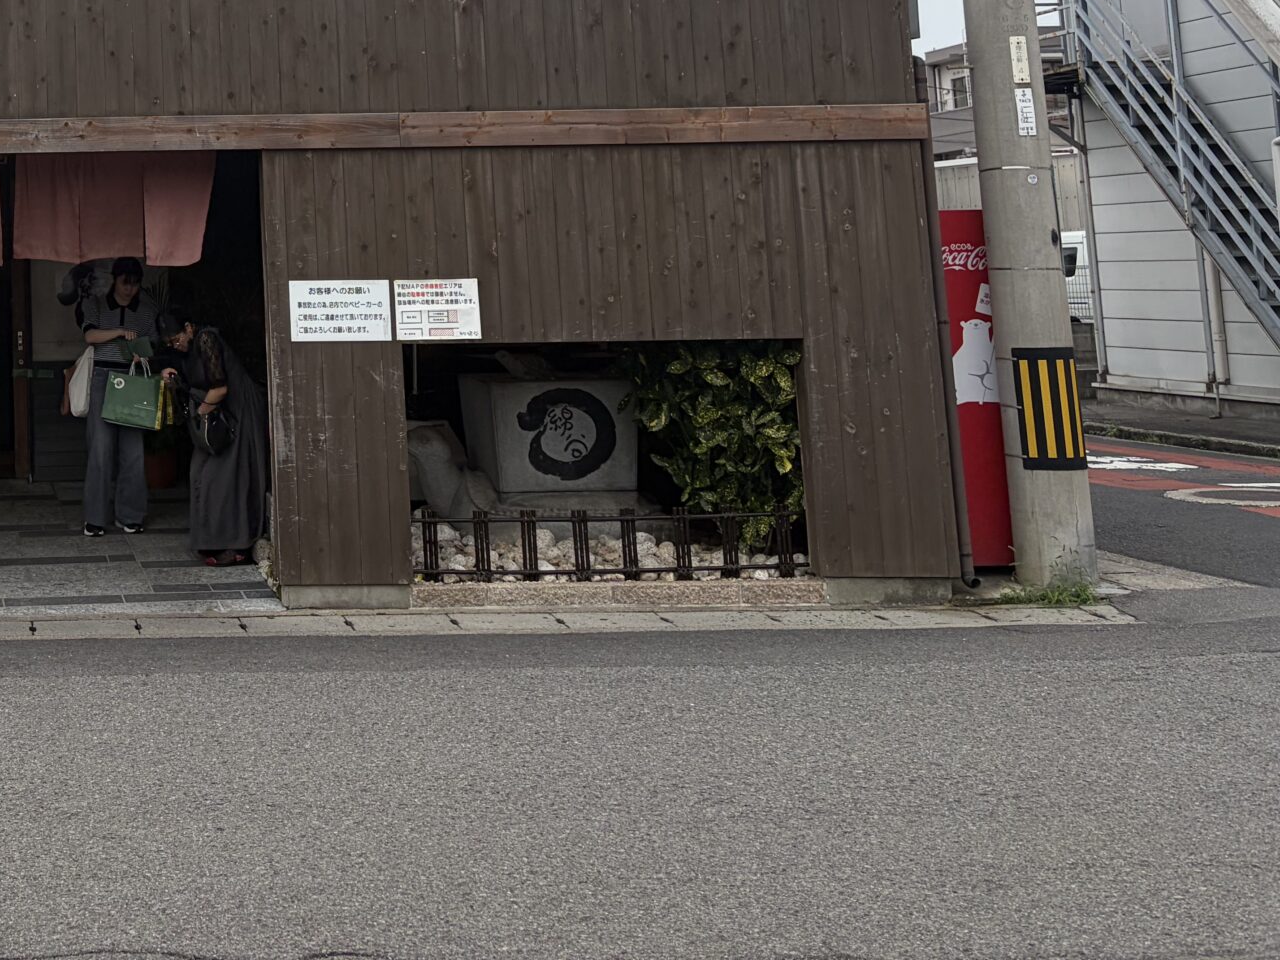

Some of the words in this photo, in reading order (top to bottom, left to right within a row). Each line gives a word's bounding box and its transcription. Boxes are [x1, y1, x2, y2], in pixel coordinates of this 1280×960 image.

[308, 286, 371, 295] お客様へのお願い
